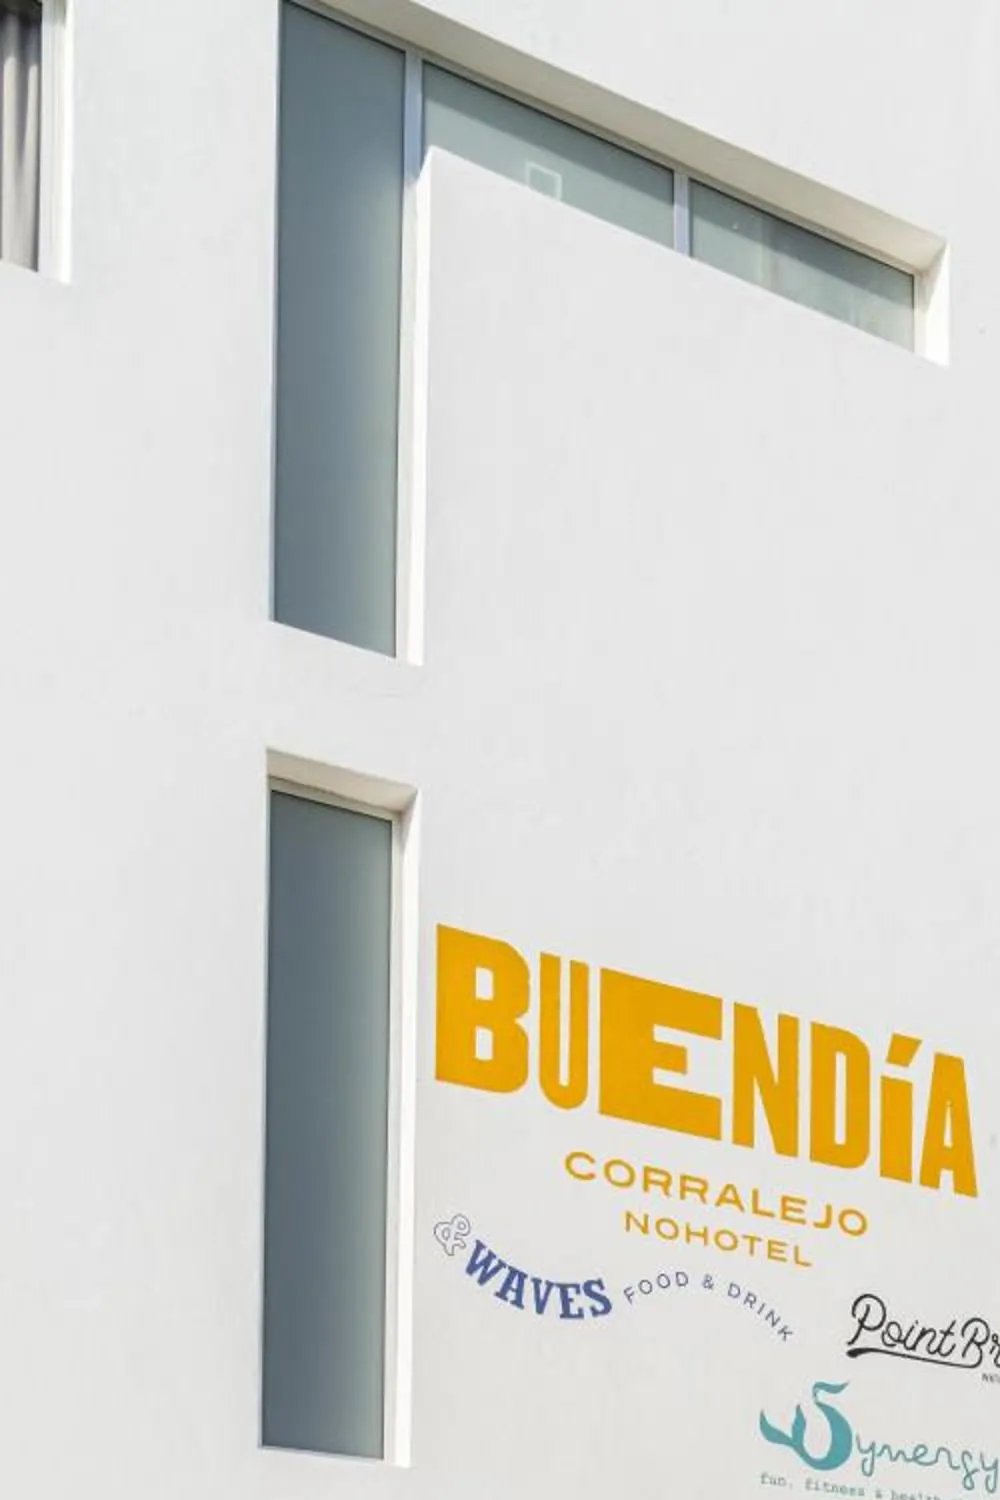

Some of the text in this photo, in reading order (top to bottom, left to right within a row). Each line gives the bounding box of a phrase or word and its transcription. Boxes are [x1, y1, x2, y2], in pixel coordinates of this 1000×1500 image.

[564, 1151, 869, 1237] CORRALEJO
[624, 1211, 813, 1268] NOHOTEL
[465, 1239, 613, 1320] WAVES
[623, 1271, 689, 1304] FOOD
[701, 1273, 715, 1290] &
[727, 1282, 793, 1342] DRINK
[759, 1379, 999, 1494] Synergy
[804, 1477, 866, 1498] fitness
